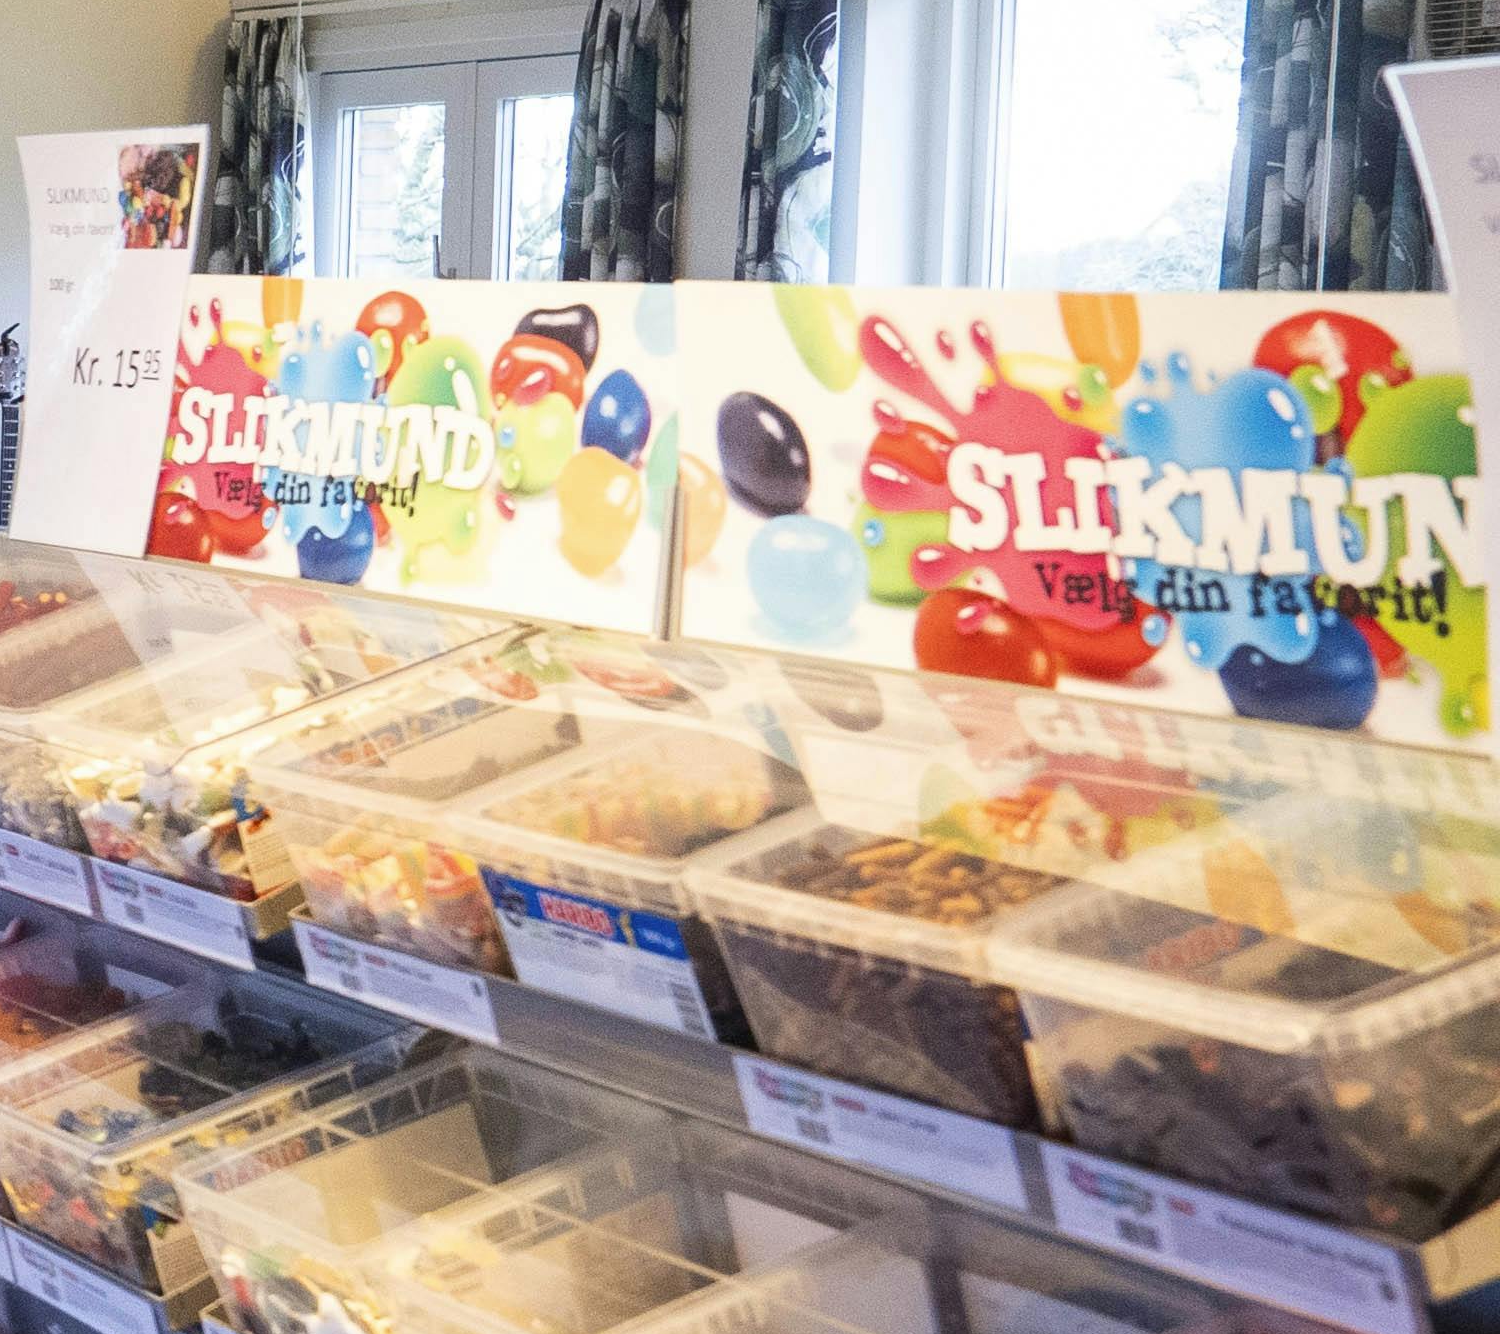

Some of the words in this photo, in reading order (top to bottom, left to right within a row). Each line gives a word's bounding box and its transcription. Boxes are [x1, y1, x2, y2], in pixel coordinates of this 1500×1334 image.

[46, 186, 110, 205] SLIKMUND
[73, 347, 103, 386] Kr.
[171, 386, 496, 491] SLIKMUND
[214, 471, 269, 514] Vælg
[274, 473, 312, 508] din
[320, 470, 421, 518] favorit!
[946, 441, 1490, 588] SLIKMUN
[1034, 561, 1139, 625] Vælg
[1155, 567, 1231, 614] din
[1247, 570, 1451, 640] favorit!
